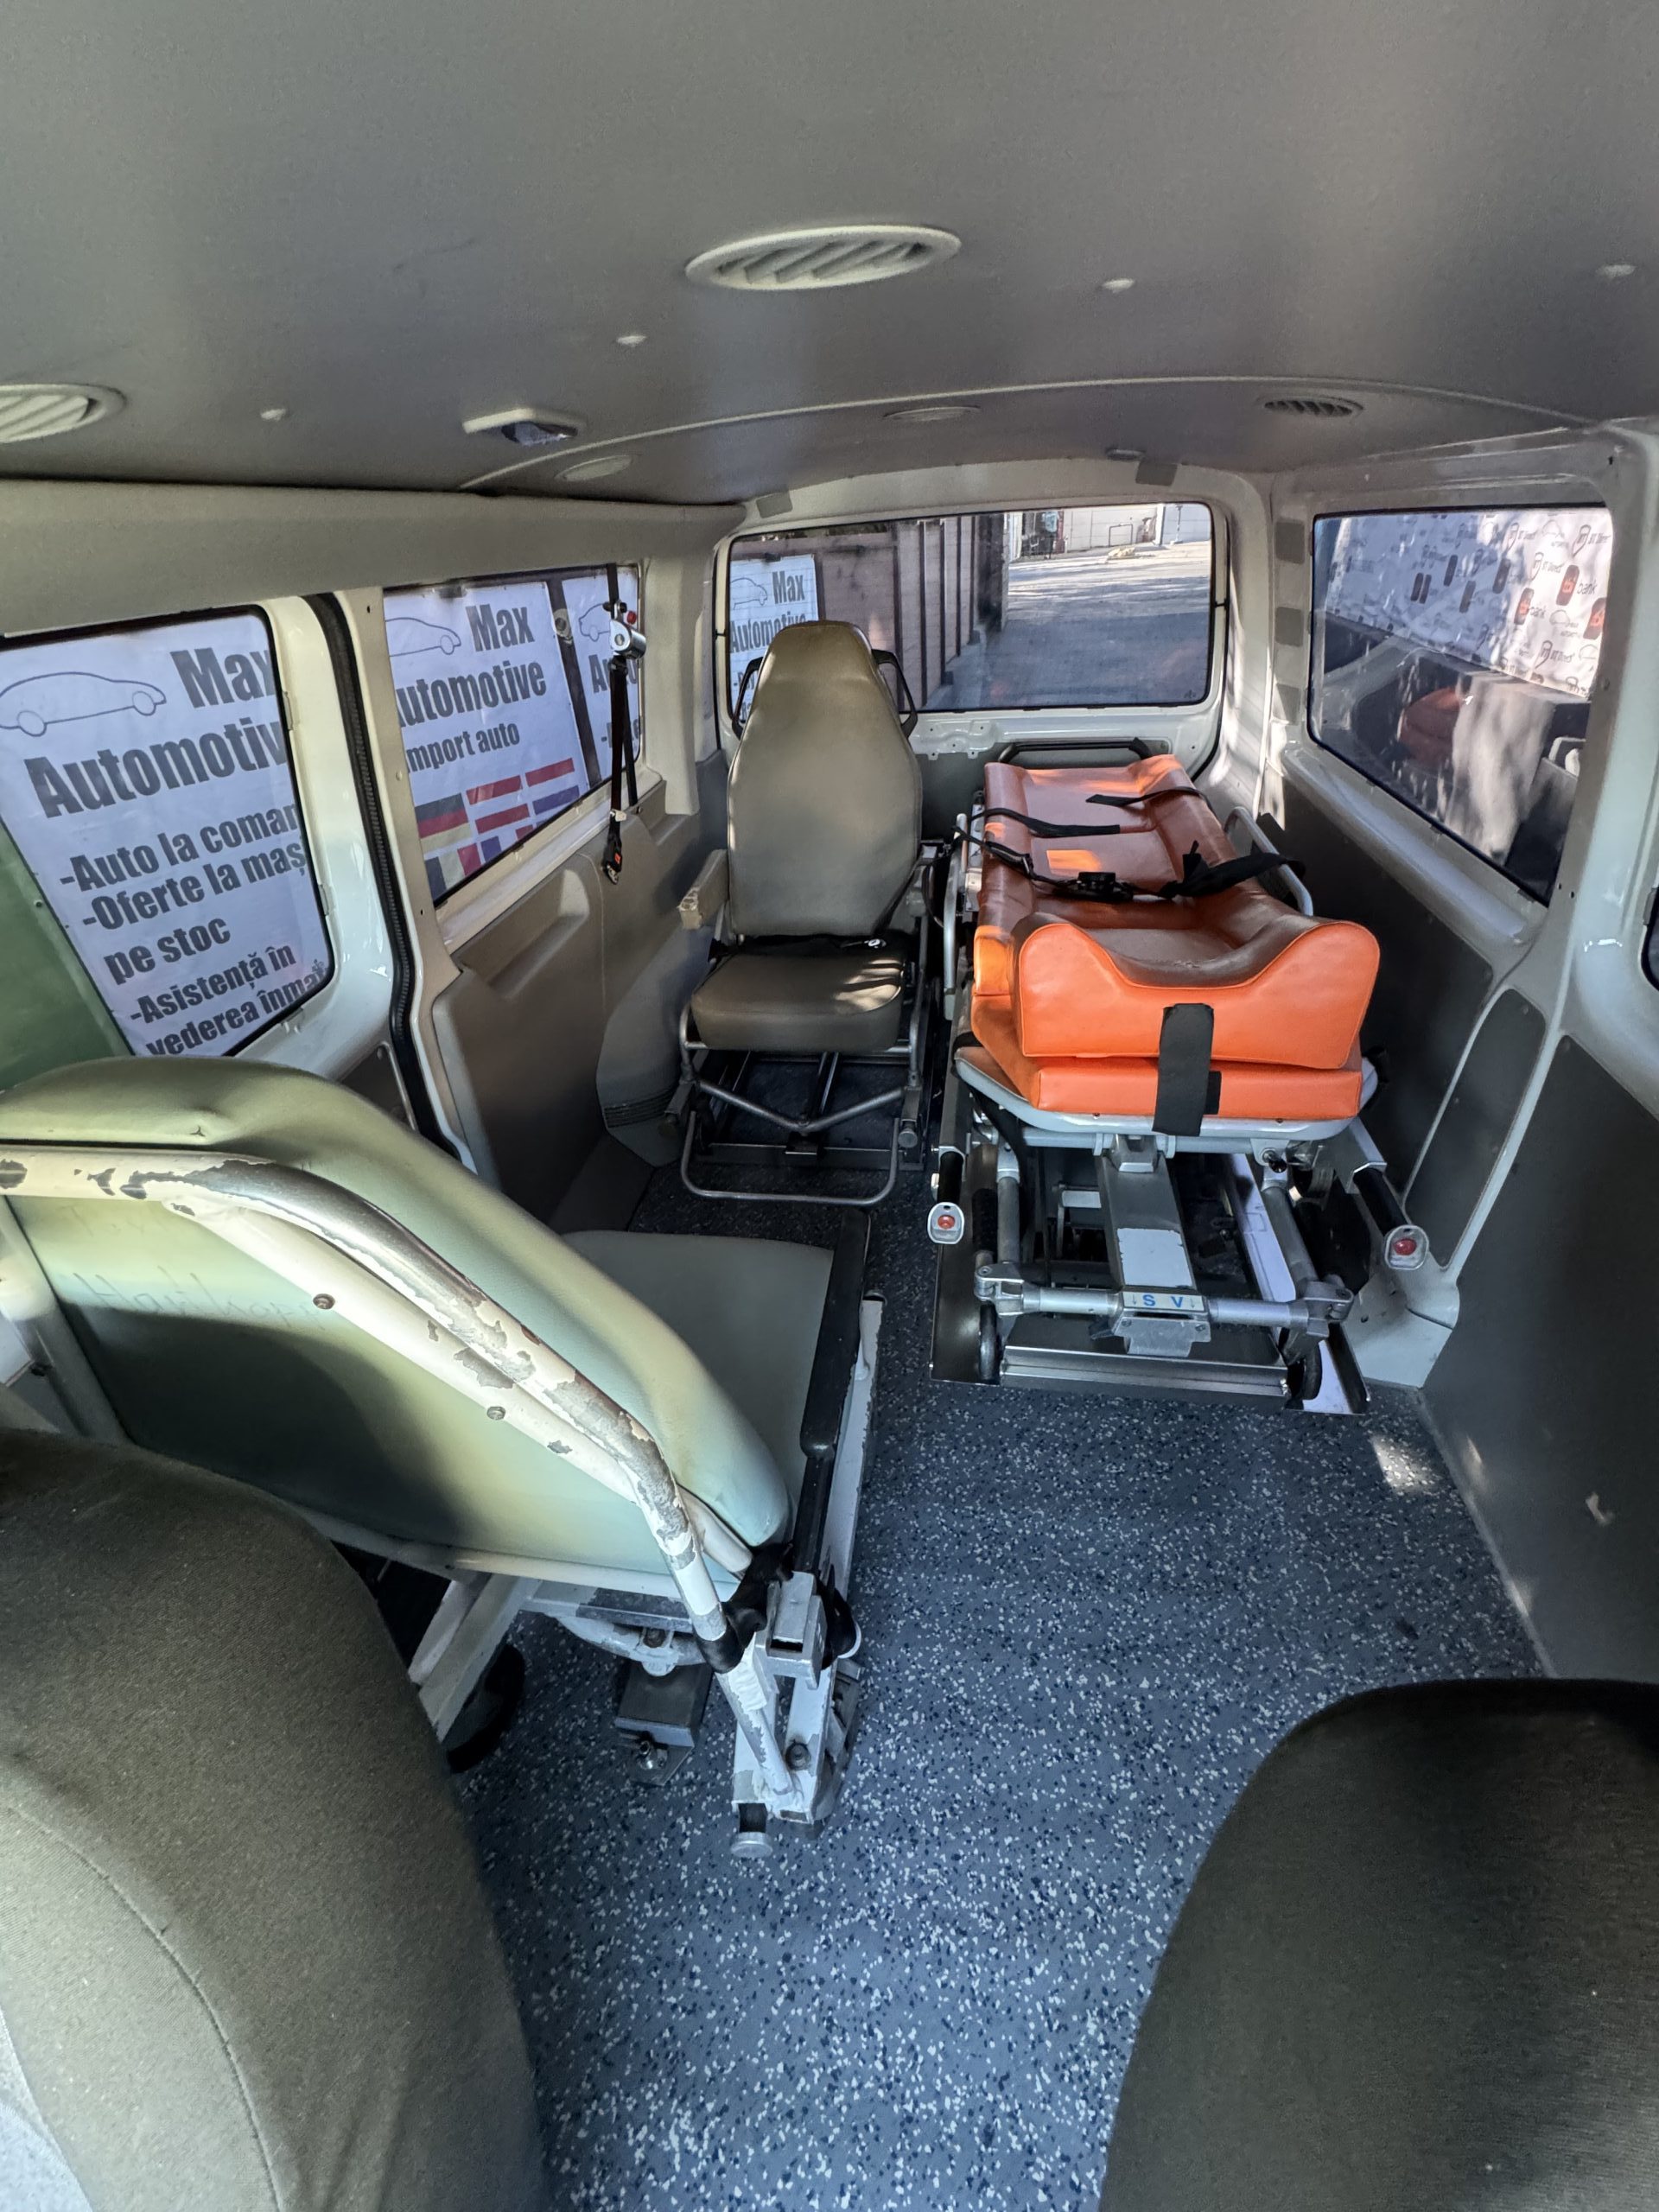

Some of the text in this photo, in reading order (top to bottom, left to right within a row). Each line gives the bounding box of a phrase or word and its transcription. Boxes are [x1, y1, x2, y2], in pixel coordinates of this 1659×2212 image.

[772, 570, 805, 605] Max
[465, 604, 536, 652] Max
[395, 660, 547, 728] utomotive
[406, 721, 520, 773] mport auto
[60, 845, 160, 892] -Auto
[157, 832, 200, 866] la
[83, 875, 206, 931] -Oferte
[203, 864, 242, 895] la
[104, 918, 232, 985] pe stoc
[265, 944, 296, 972] în
[145, 1001, 260, 1055] vederea
[1142, 1294, 1184, 1308] S V
